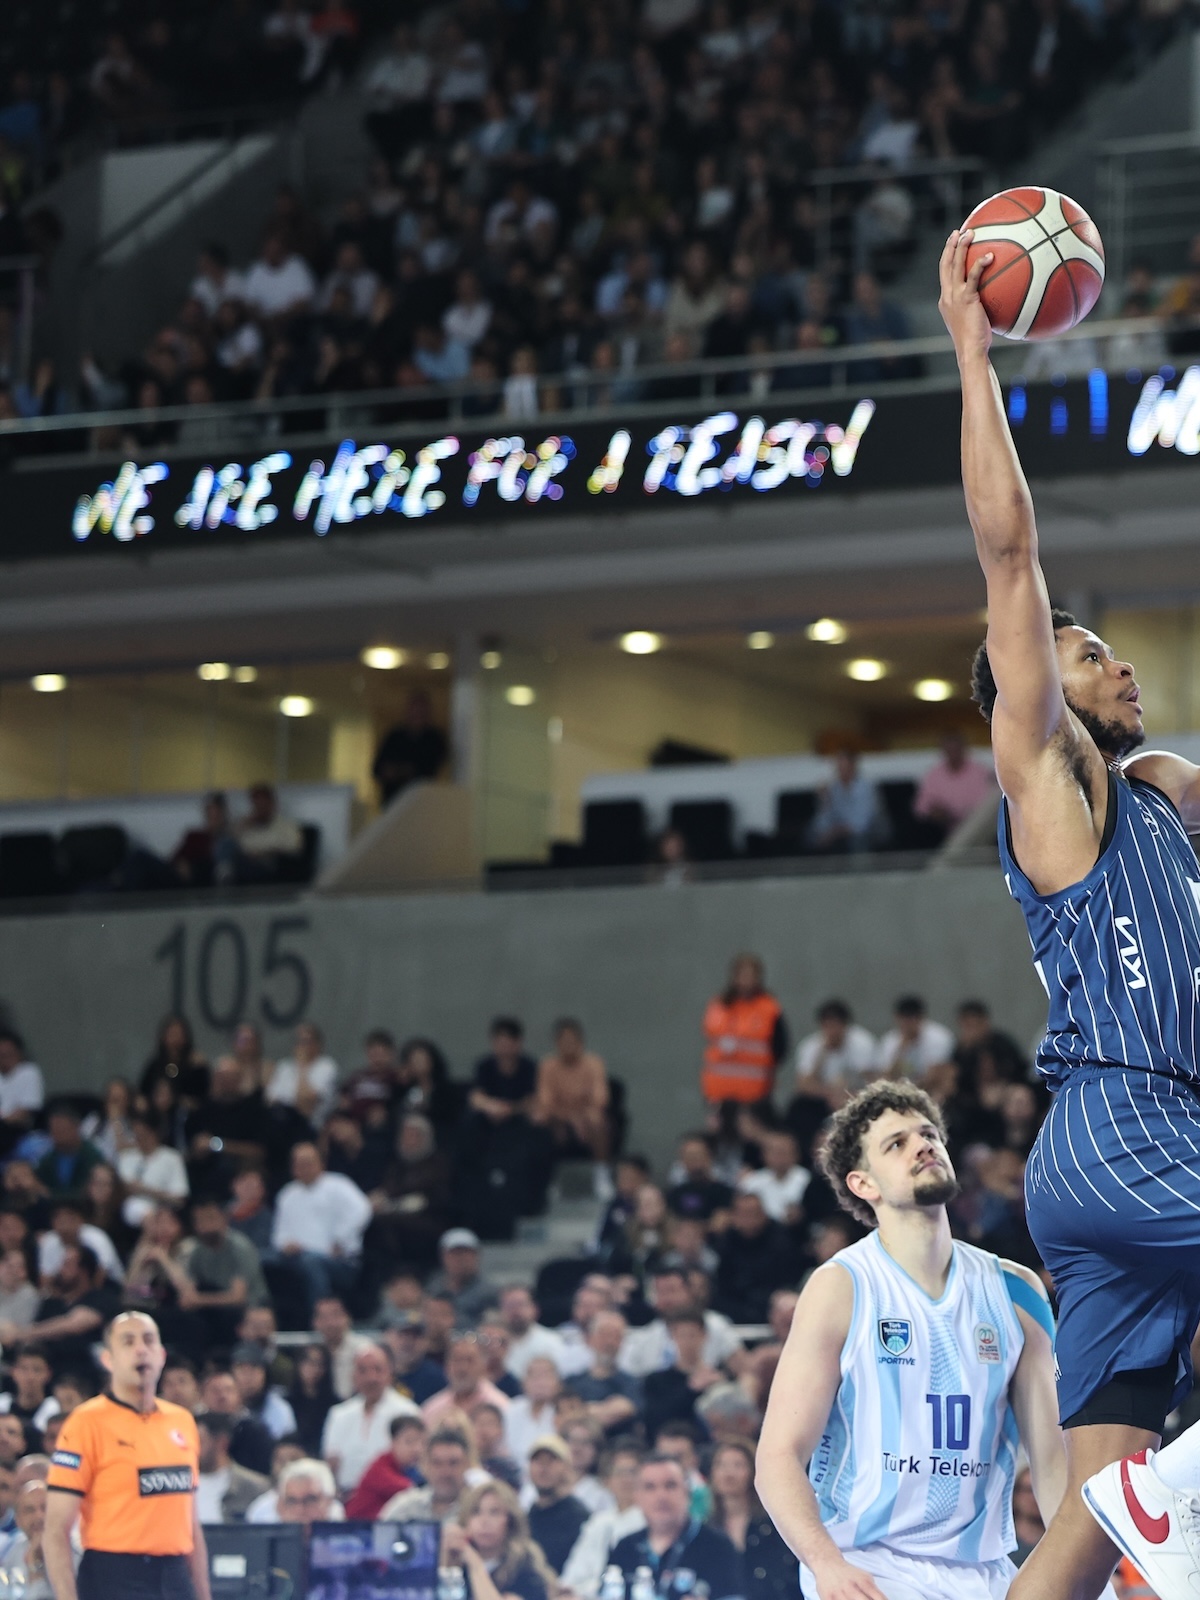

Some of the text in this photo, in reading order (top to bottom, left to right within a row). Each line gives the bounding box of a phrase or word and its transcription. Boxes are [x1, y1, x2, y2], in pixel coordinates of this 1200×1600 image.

[72, 462, 170, 541] WE
[293, 436, 461, 536] HERE
[154, 915, 311, 1031] 105
[926, 1394, 971, 1450] 10
[883, 1452, 991, 1477] Türk Telekom
